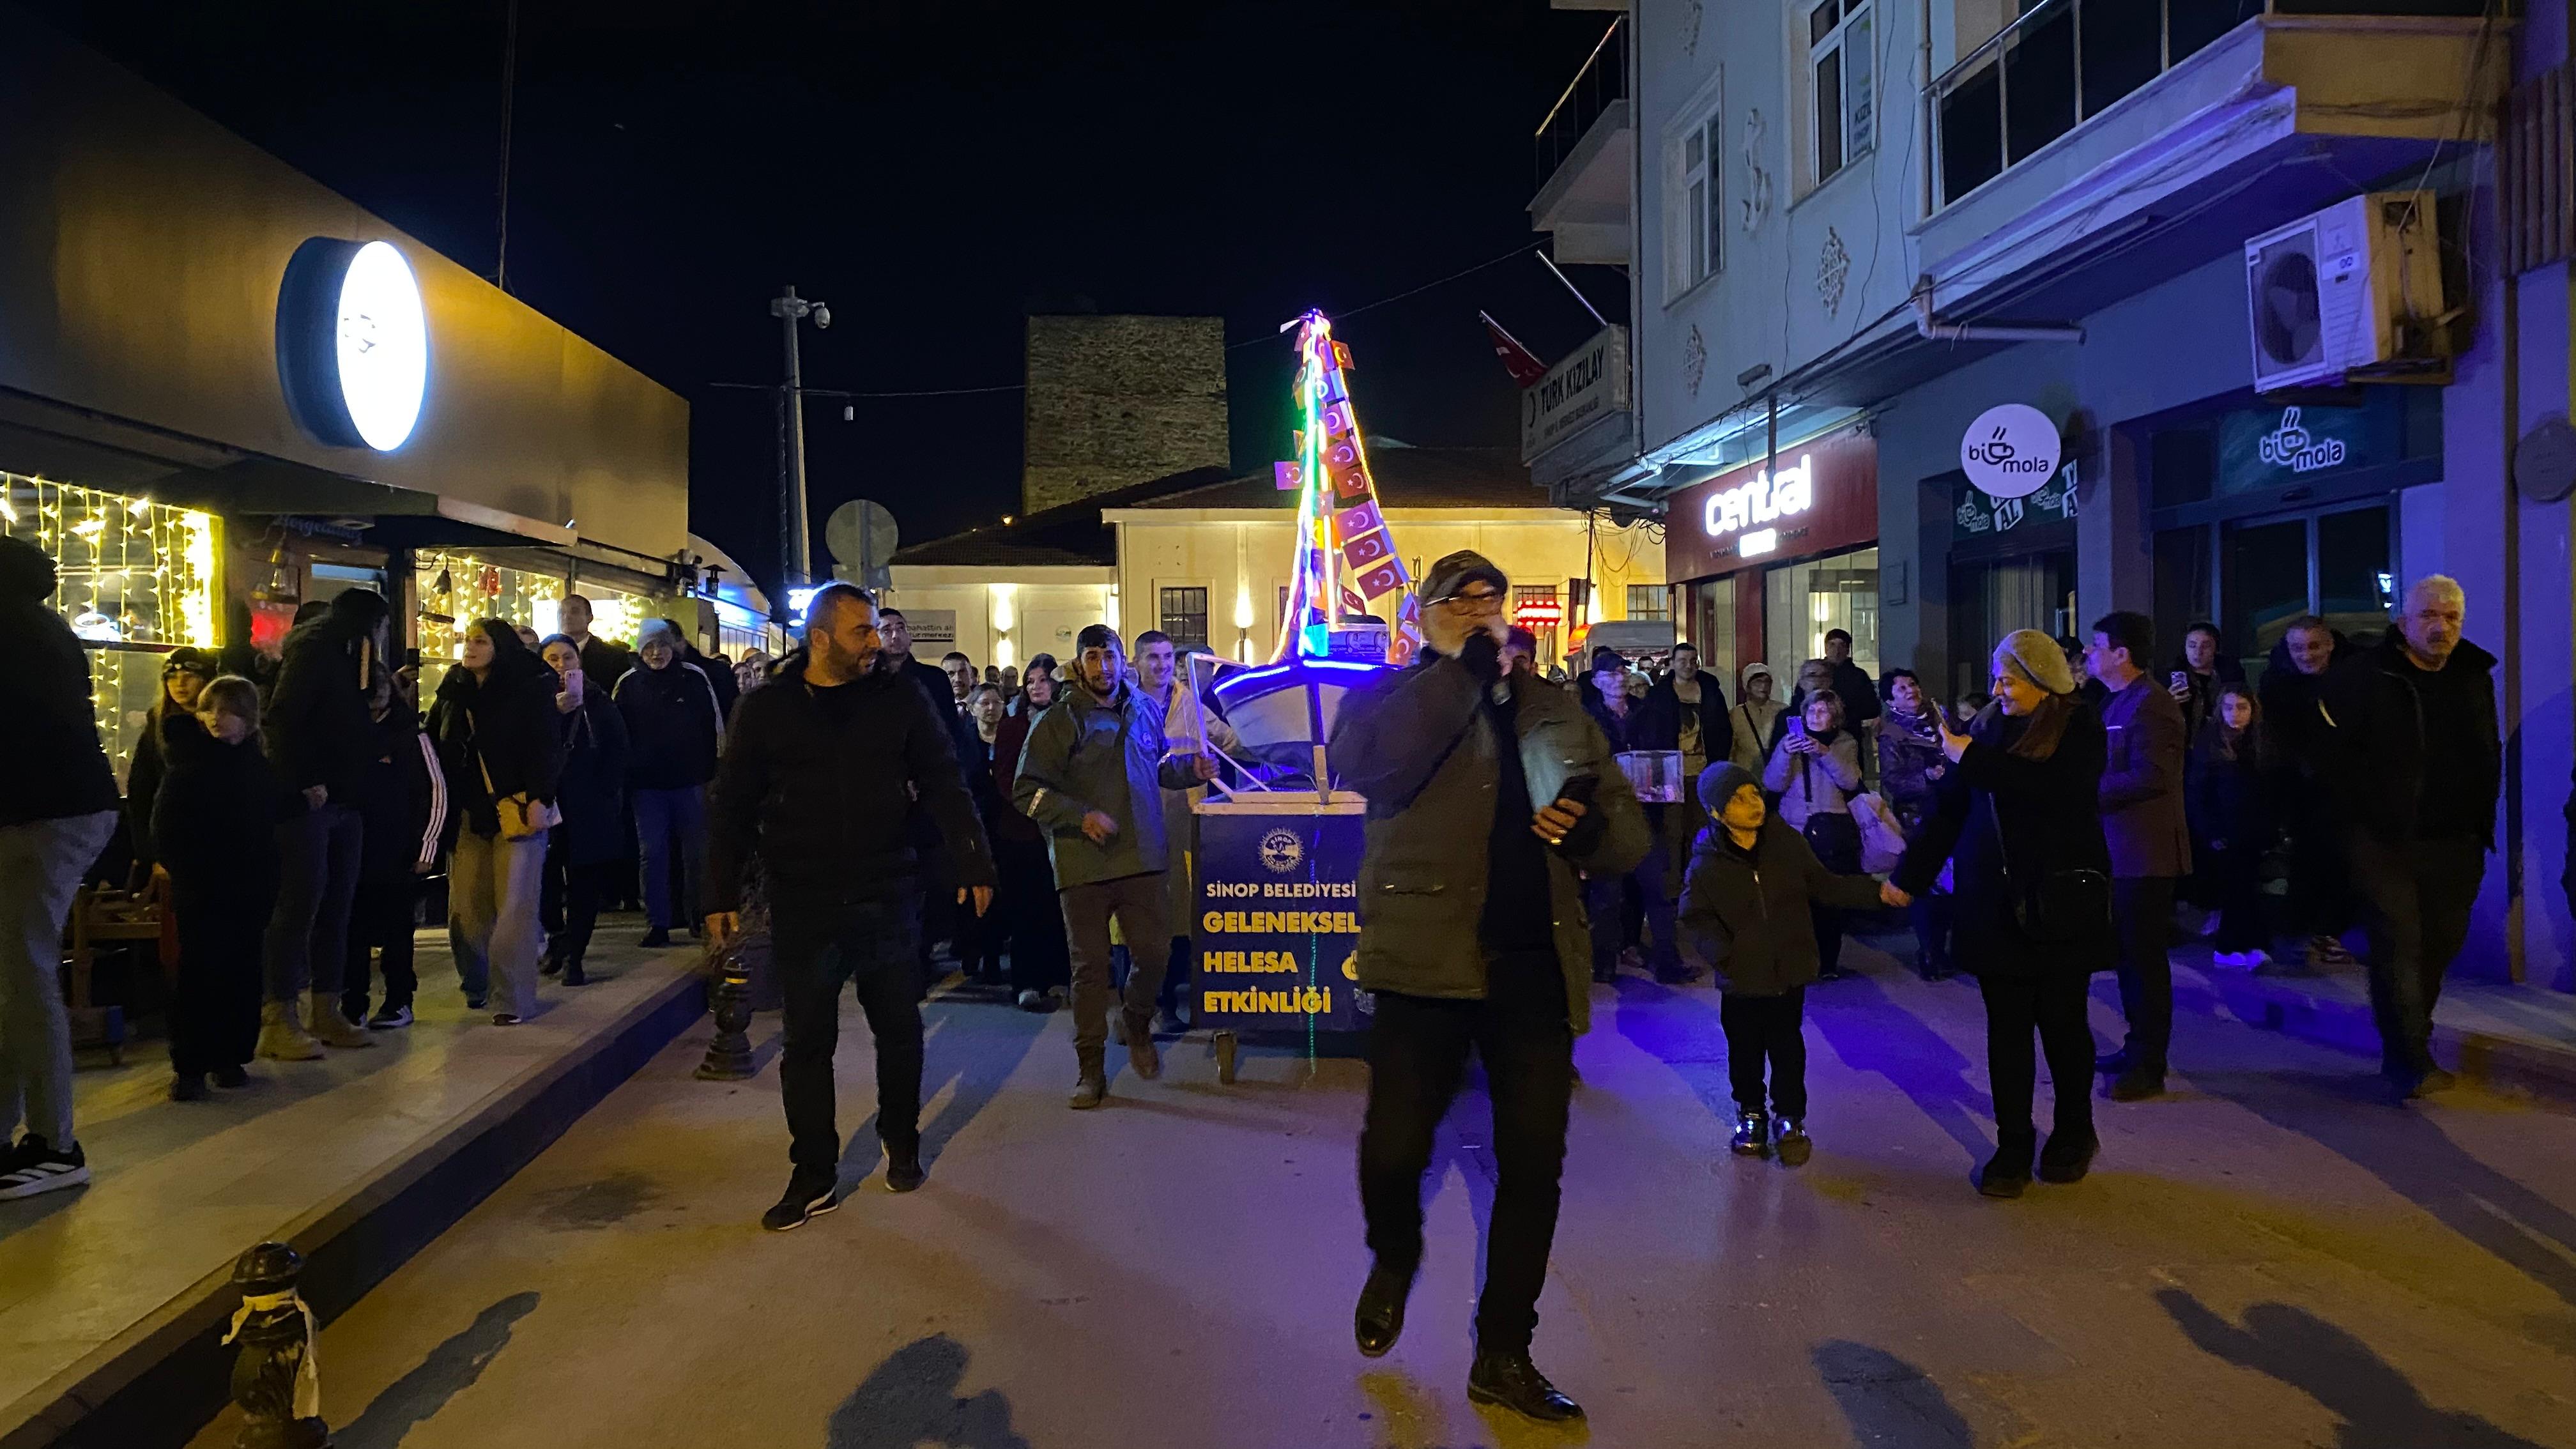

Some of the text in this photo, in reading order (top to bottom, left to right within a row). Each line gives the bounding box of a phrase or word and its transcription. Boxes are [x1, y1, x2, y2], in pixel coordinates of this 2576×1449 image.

[1541, 344, 1604, 416] TÜRK KIZILAY
[2003, 456, 2049, 473] mola
[2296, 440, 2343, 470] mola
[1706, 454, 1812, 535] central
[1206, 880, 1356, 898] SİNOP BELEDİYESİ
[1203, 911, 1361, 933] GELENEKSEL
[1204, 951, 1298, 973] HELESA
[1204, 986, 1331, 1013] ETKİNLİĞİ
